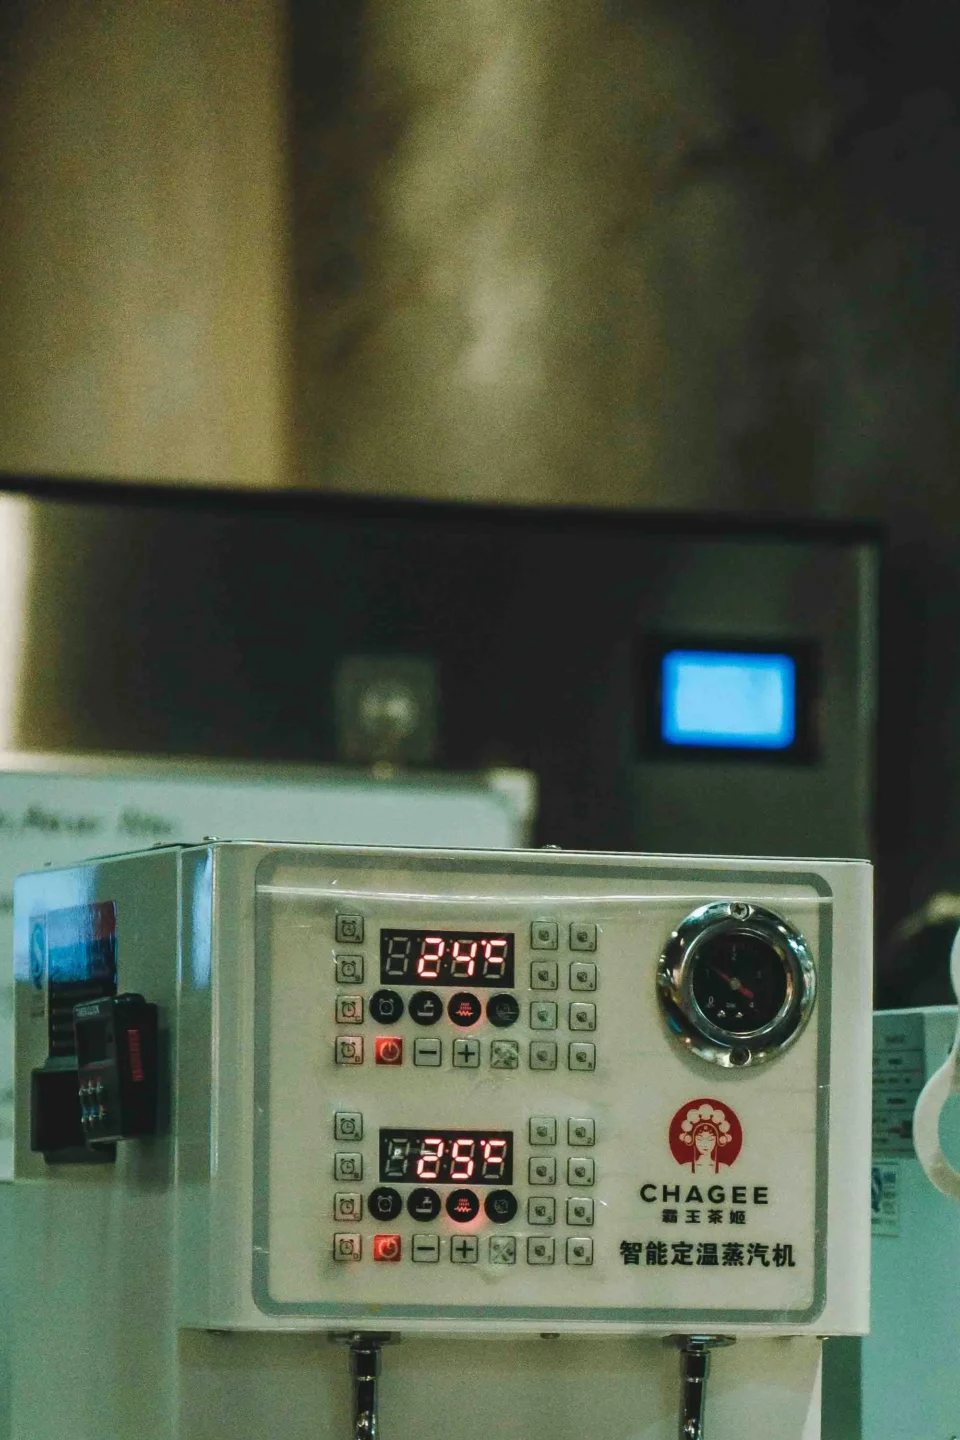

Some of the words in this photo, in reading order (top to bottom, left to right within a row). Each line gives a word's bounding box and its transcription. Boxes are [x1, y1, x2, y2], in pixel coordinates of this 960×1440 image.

[640, 1183, 769, 1204] CHAGEE
[661, 1208, 746, 1225] 霸王茶姬
[619, 1240, 796, 1268] 智能定温蒸汽机
